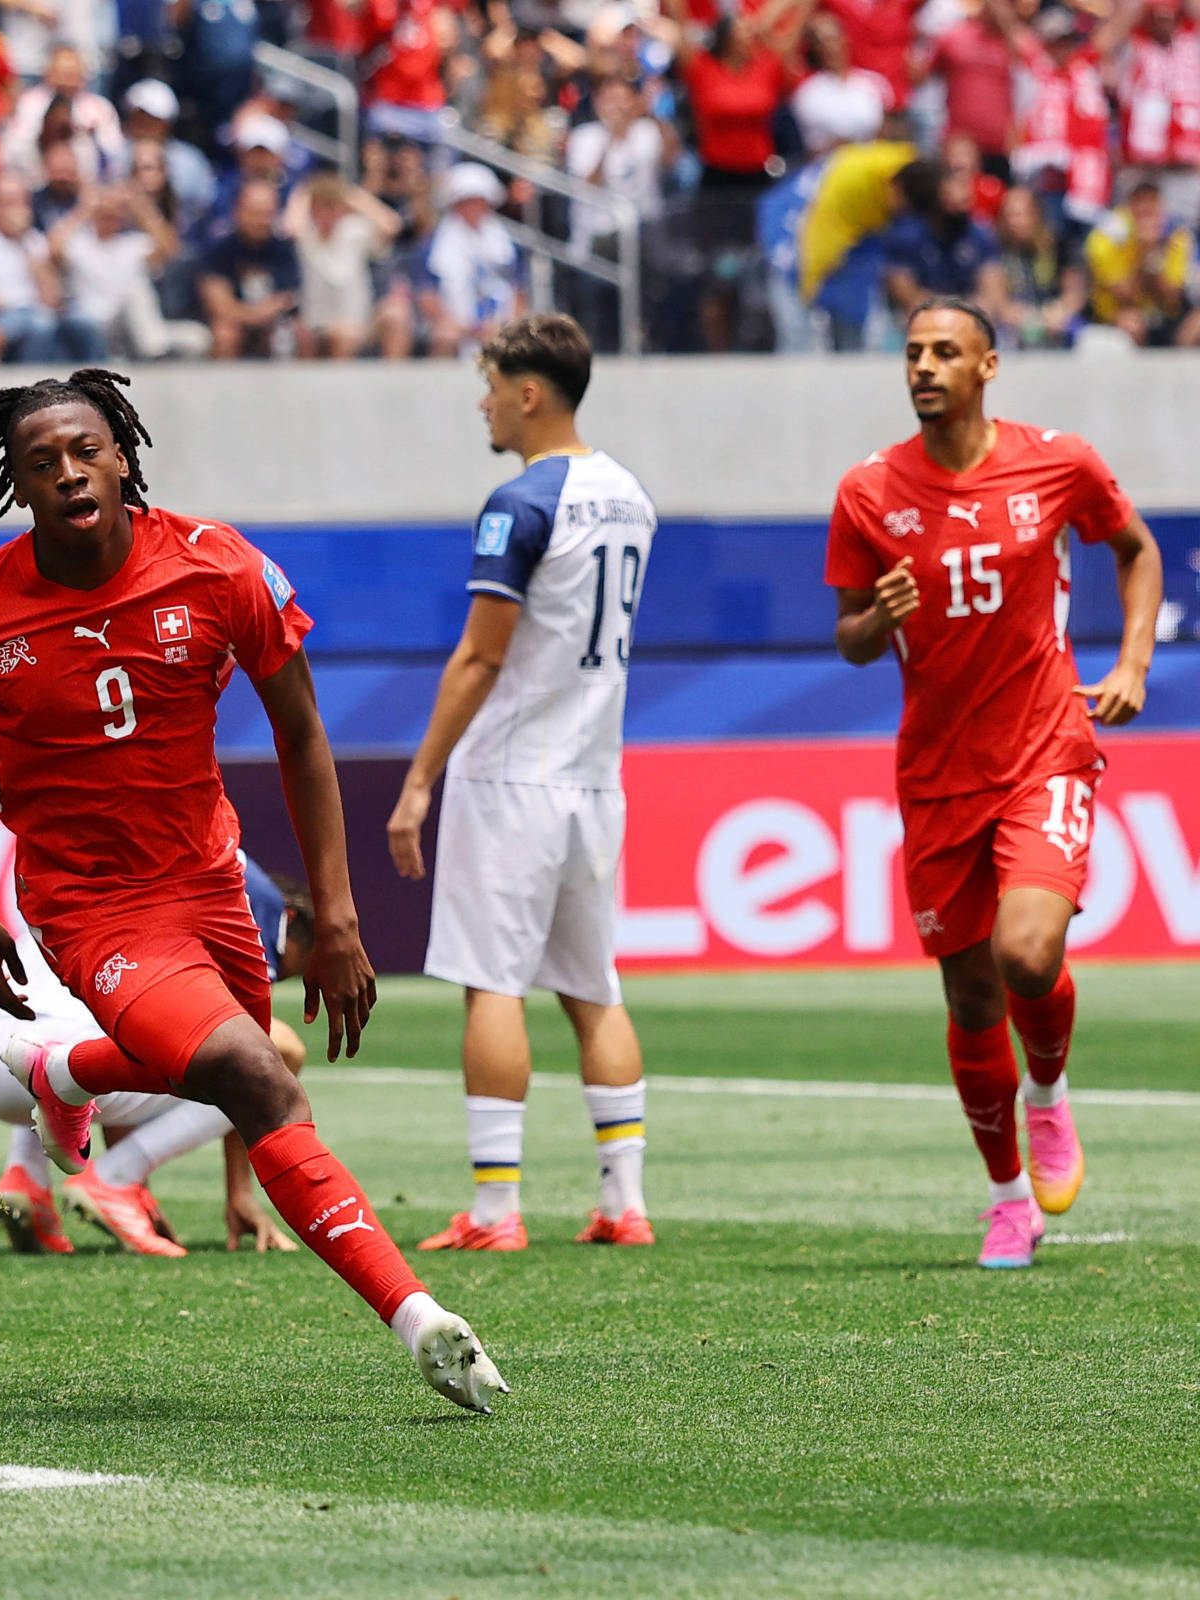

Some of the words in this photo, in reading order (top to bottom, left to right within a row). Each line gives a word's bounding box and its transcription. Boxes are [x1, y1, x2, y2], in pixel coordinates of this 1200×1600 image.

[580, 545, 640, 671] 19
[940, 542, 1004, 618] 15
[95, 665, 138, 739] 9
[1041, 775, 1093, 845] 15
[308, 1195, 358, 1233] suisse
